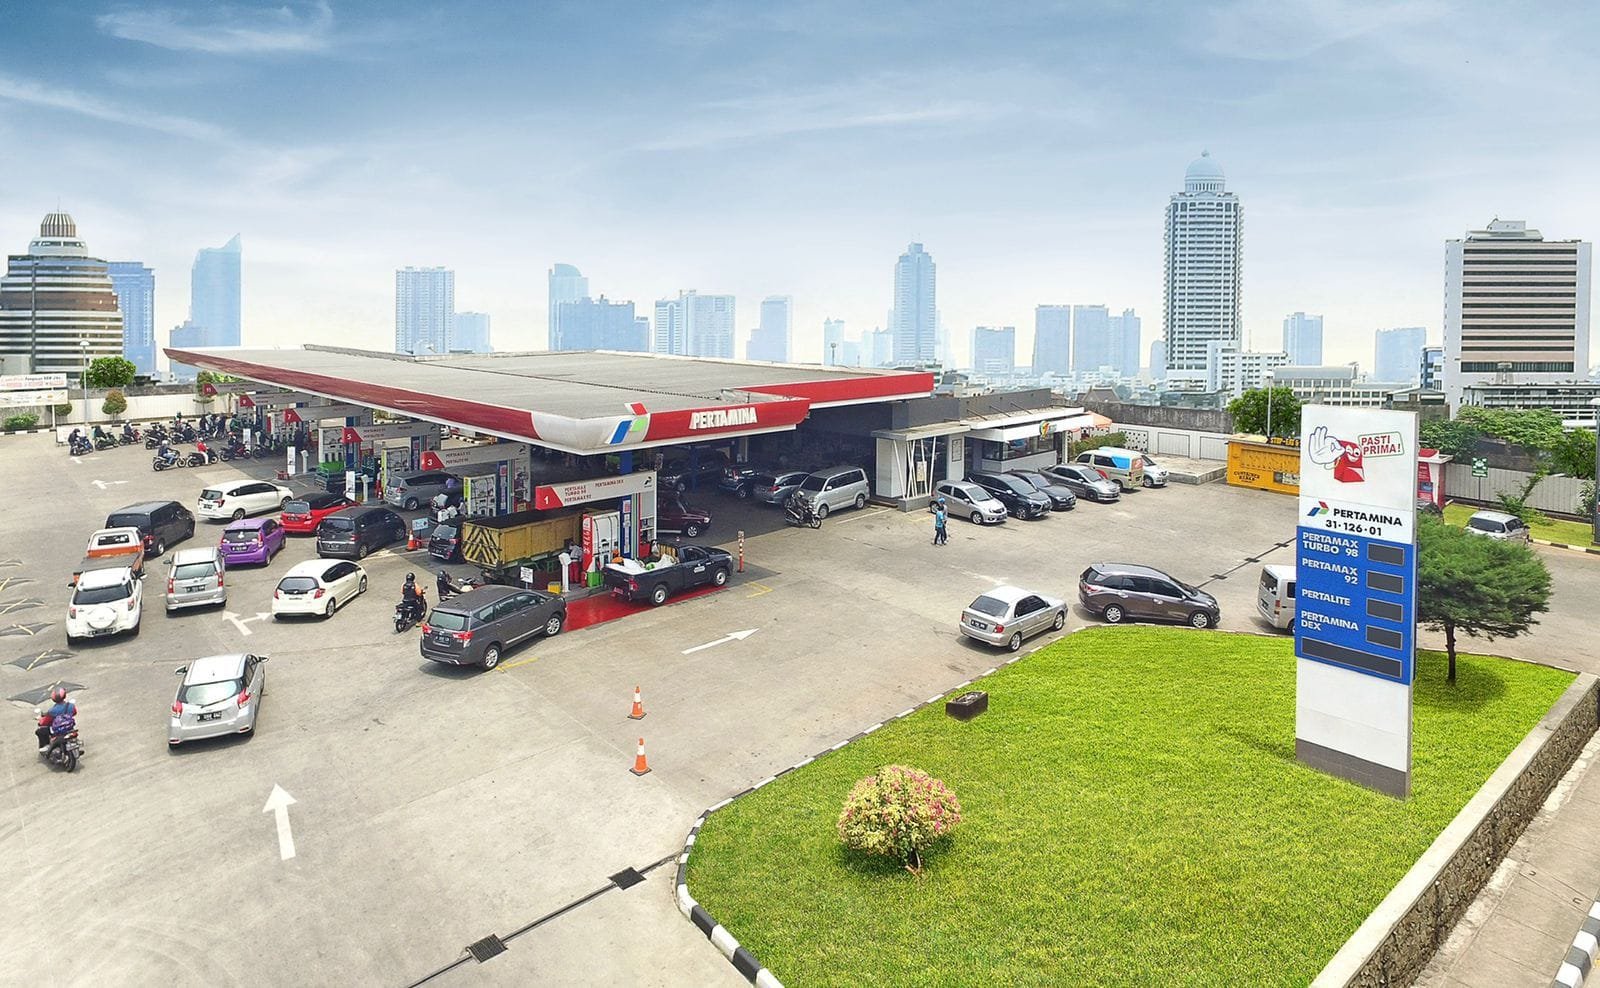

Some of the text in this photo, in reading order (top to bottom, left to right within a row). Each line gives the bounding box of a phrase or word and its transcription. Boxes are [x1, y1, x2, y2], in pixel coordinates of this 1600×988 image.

[689, 407, 758, 429] PERTAMINA
[1361, 435, 1390, 446] PASTI
[1363, 444, 1401, 455] PRIMA!
[544, 496, 549, 504] 1
[1334, 508, 1402, 526] PERTAMINA
[1303, 532, 1359, 548] PERTAMAX
[1303, 541, 1359, 557] TURBO 98
[1302, 558, 1358, 576] PERTAMAX
[1344, 575, 1358, 585] 92
[1302, 589, 1350, 606] PERTALITE
[1301, 610, 1359, 631] PERTAMINA
[1301, 619, 1321, 631] DEX
